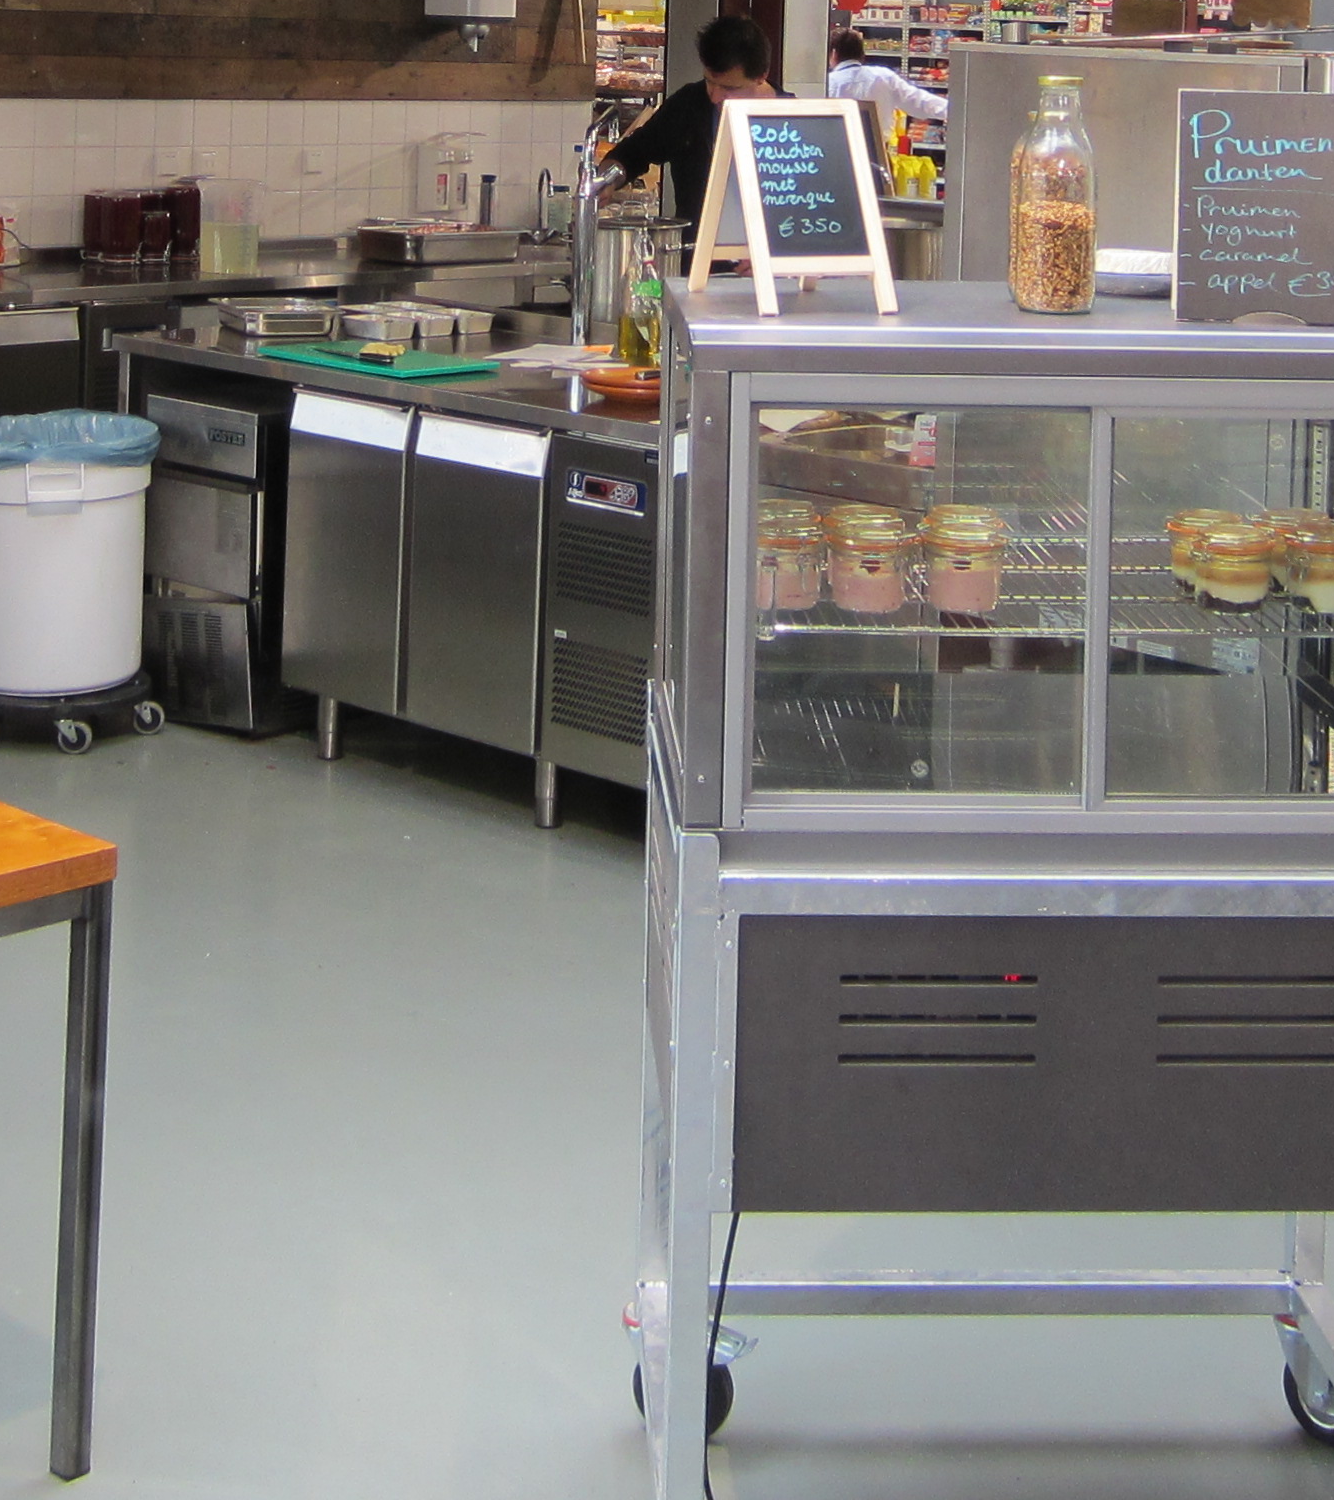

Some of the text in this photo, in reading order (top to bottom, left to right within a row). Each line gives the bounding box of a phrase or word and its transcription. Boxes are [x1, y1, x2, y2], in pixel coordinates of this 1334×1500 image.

[758, 161, 819, 175] mousse
[761, 177, 797, 192] met
[1196, 195, 1301, 218] Pruimen
[1199, 248, 1313, 266] caramel
